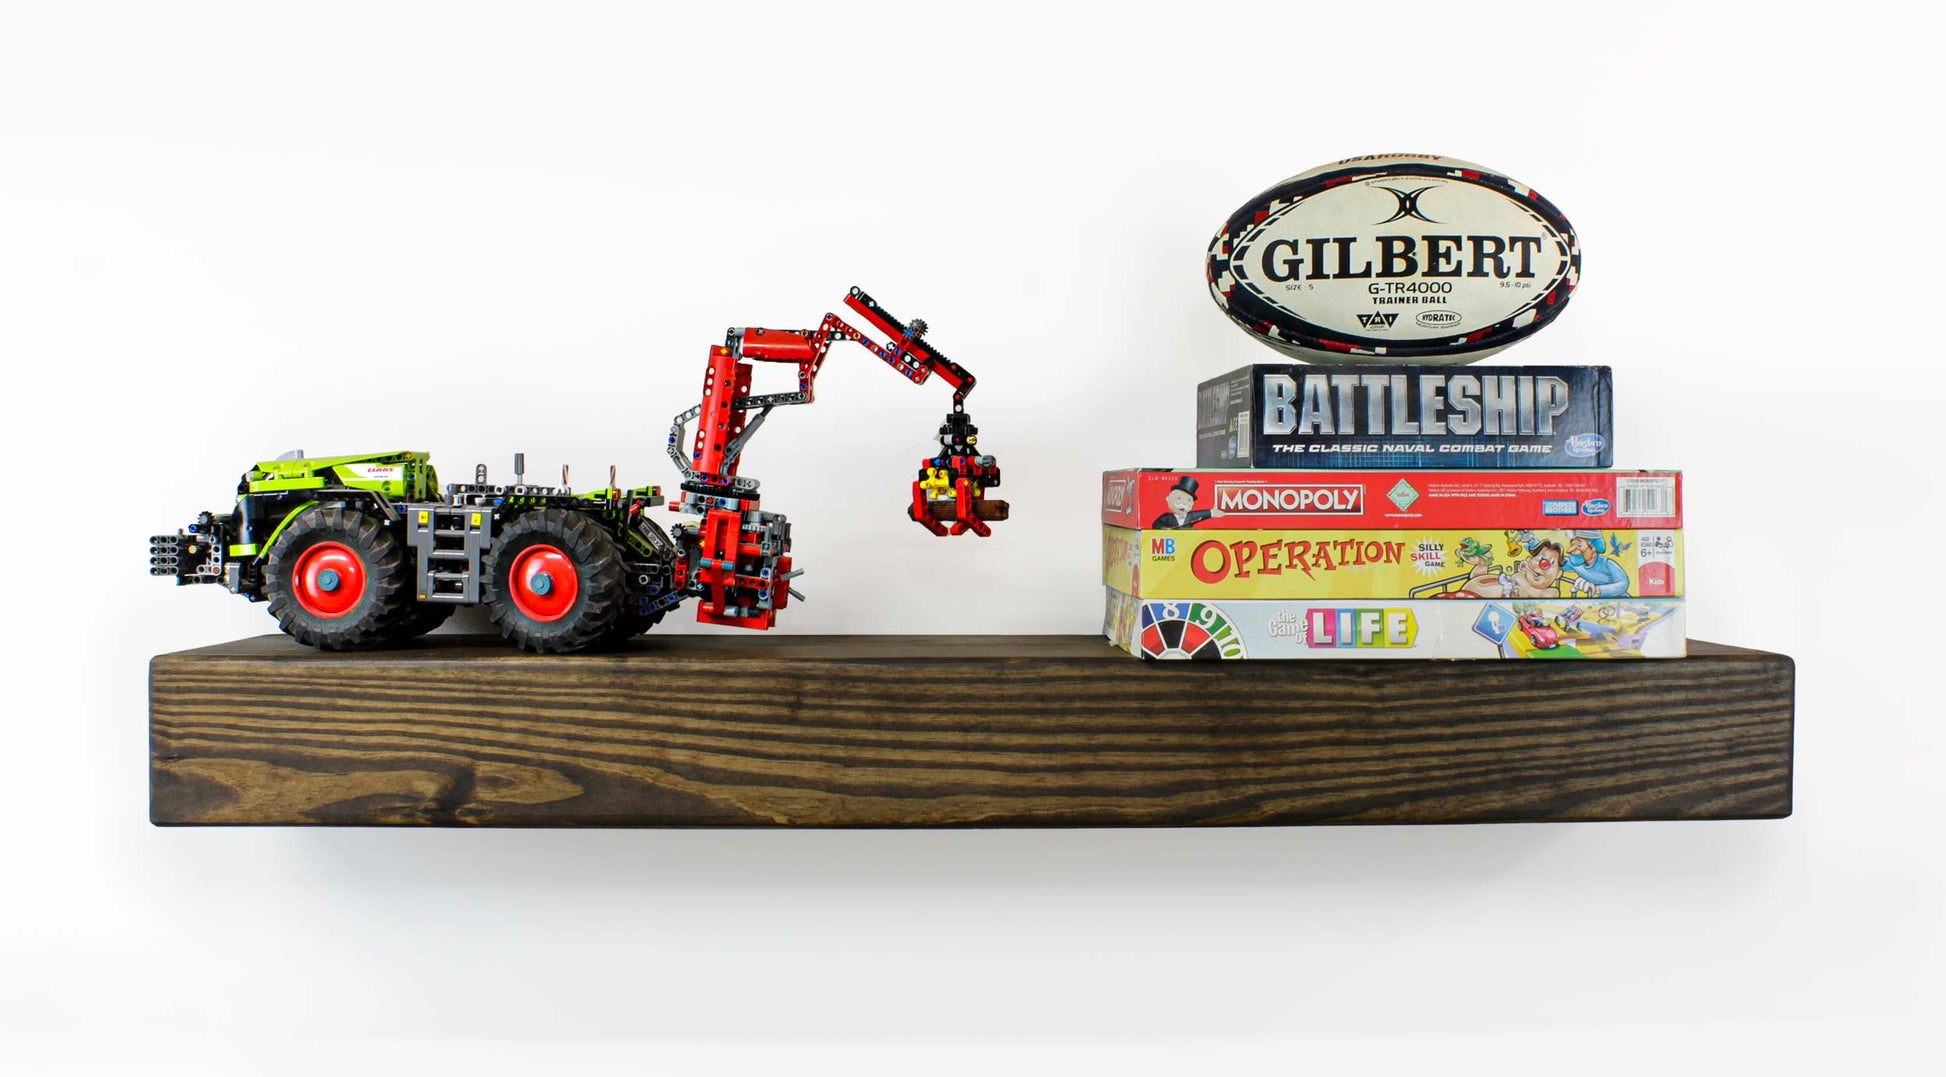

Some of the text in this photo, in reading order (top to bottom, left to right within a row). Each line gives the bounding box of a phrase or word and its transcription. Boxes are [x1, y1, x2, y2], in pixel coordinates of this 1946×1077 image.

[1261, 236, 1542, 282] GILBERT
[1368, 282, 1452, 294] G-TR4000
[1372, 296, 1447, 304] TRAINER BALL
[1422, 313, 1456, 322] HYDRATEC
[1263, 374, 1568, 435] BATTLESHIP
[1272, 444, 1552, 453] THE CLASSIC NAVAL COMBAT GAME
[1221, 489, 1359, 510] MONOPOLY
[1152, 538, 1175, 554] MB
[1641, 548, 1652, 557] 6+
[1191, 539, 1405, 584] OPERATION
[1411, 552, 1441, 561] SKILL
[1276, 609, 1296, 623] the
[1268, 617, 1309, 636] Game
[1313, 612, 1408, 644] LIFE
[1296, 631, 1309, 644] of
